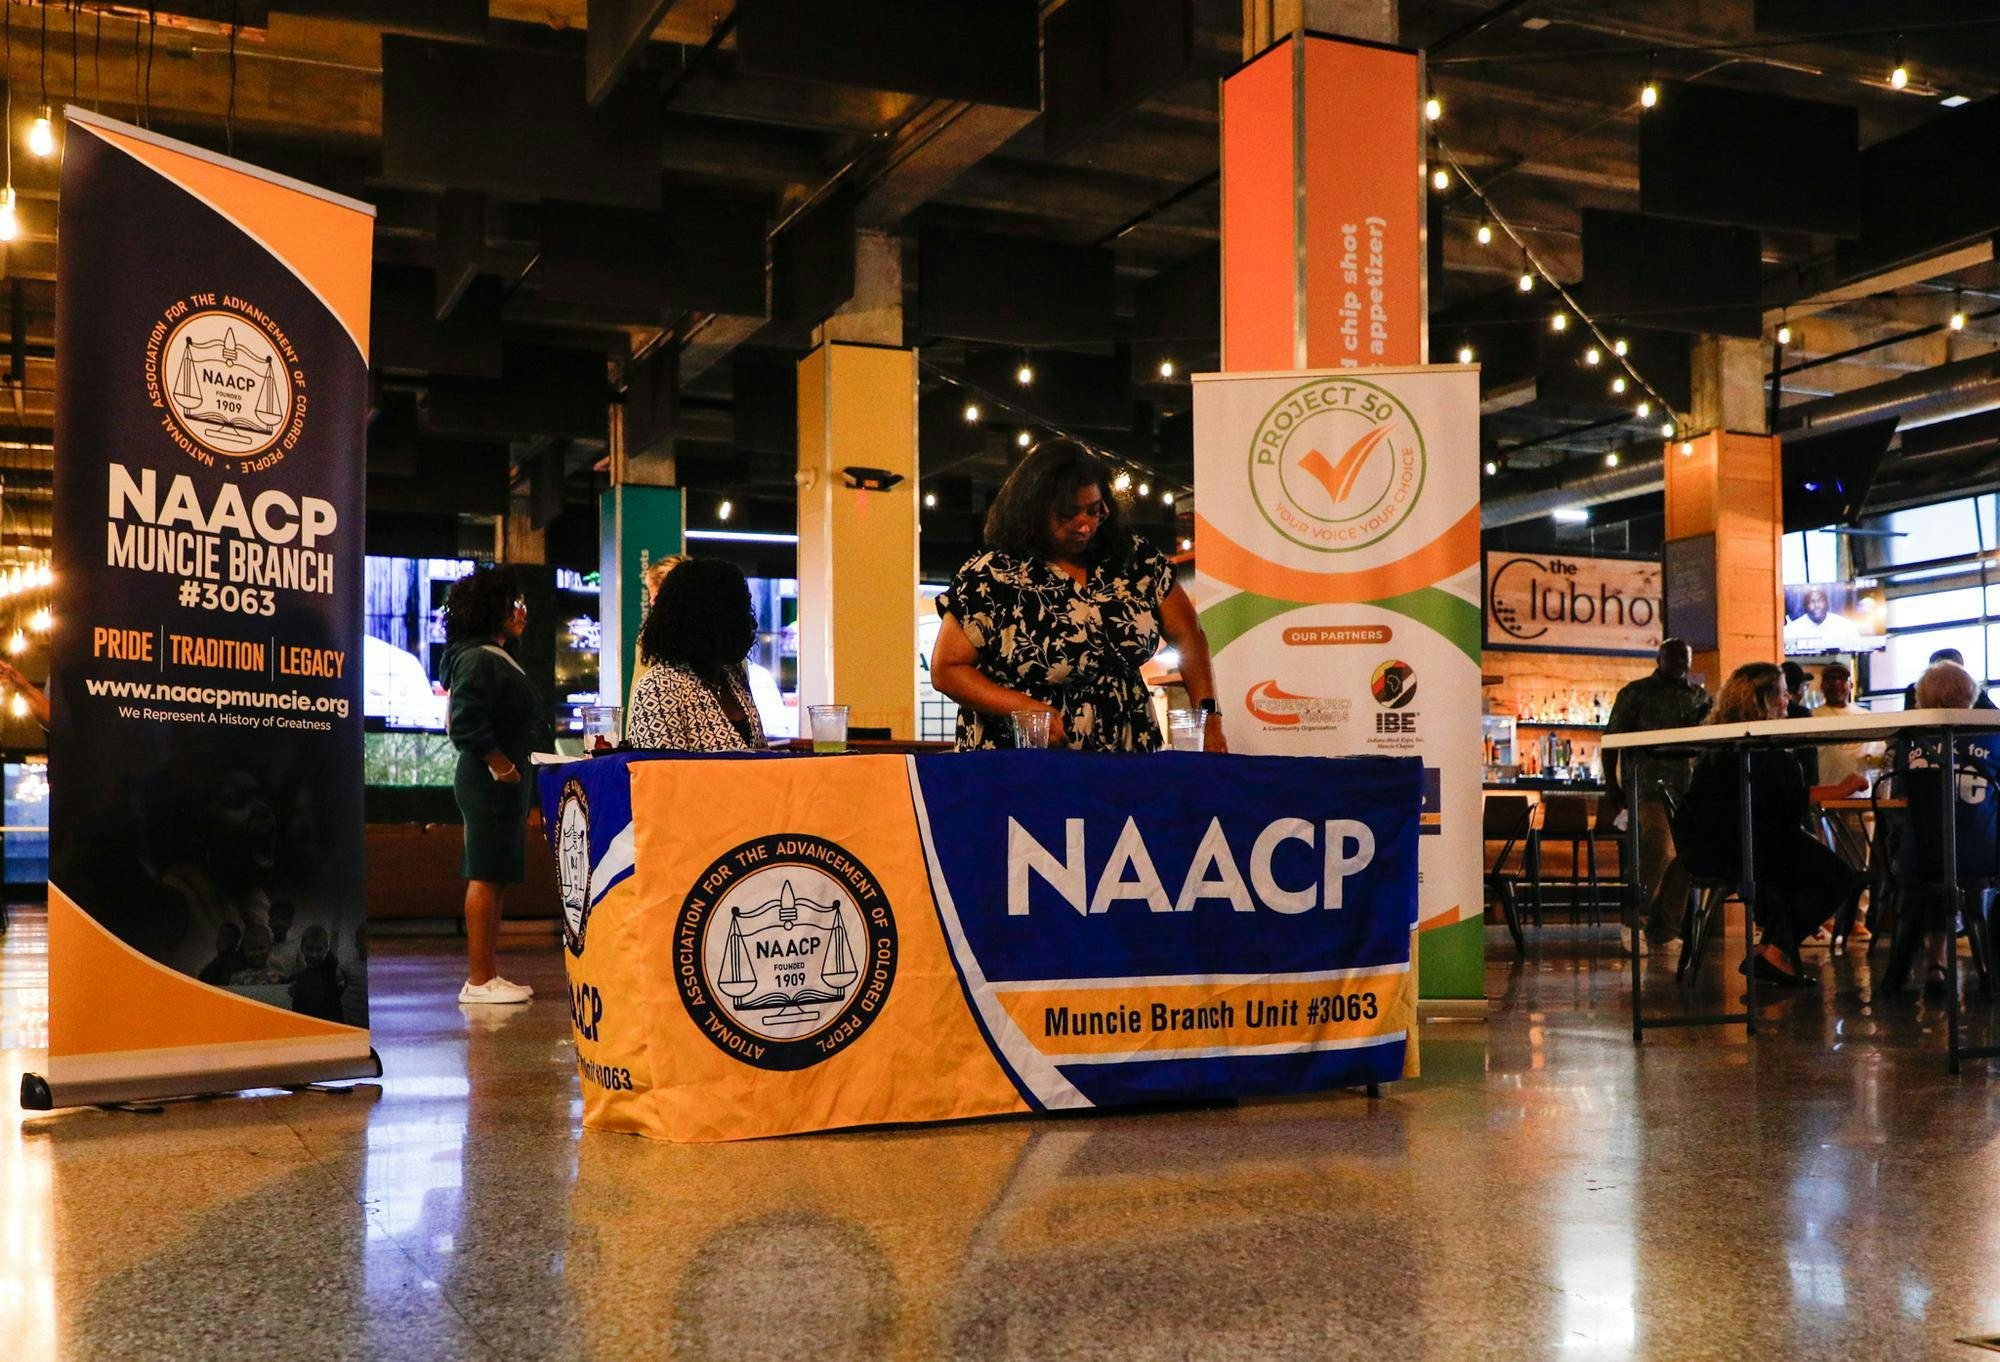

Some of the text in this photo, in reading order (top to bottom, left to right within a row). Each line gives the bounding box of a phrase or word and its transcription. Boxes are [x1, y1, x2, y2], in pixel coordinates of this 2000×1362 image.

[1340, 223, 1358, 284] shot
[1364, 216, 1388, 356] appetizer)
[1339, 291, 1362, 351] chip
[145, 293, 307, 474] NATIONAL ASSOCIATION FOR THE ADVANCEMENT OF COLORED PEOPLE
[203, 368, 256, 392] NAACP
[216, 399, 242, 413] 1909
[1257, 386, 1393, 465] PROJECT 50
[109, 462, 337, 548] NAACP
[1275, 446, 1414, 541] YOUR VOICE YOUR CHOICE
[107, 521, 334, 594] MUNCIE BRANCH
[1550, 560, 1577, 575] the
[179, 580, 276, 616] #3063
[1490, 558, 1663, 640] Clubho
[94, 627, 345, 679] PRIDE TRADITION LEGACY
[1291, 630, 1383, 641] OUR PARTNERS
[86, 679, 349, 718] www.naacpmuncie.org
[118, 706, 331, 731] We Represent A History of Greatness
[1376, 712, 1416, 733] IBE
[1968, 743, 1991, 760] for
[736, 844, 768, 867] THE
[776, 841, 878, 900] ADVANCEMENT
[1008, 815, 1375, 917] NAACP
[703, 864, 733, 895] FOR
[871, 907, 888, 928] OF
[680, 899, 707, 1006] ASSOCIATION
[756, 936, 821, 959] NAACP
[774, 962, 805, 971] FOUNDED
[775, 973, 805, 988] 1909
[861, 938, 891, 1012] COLORED
[1045, 992, 1378, 1037] Muncie Branch Unit #3063
